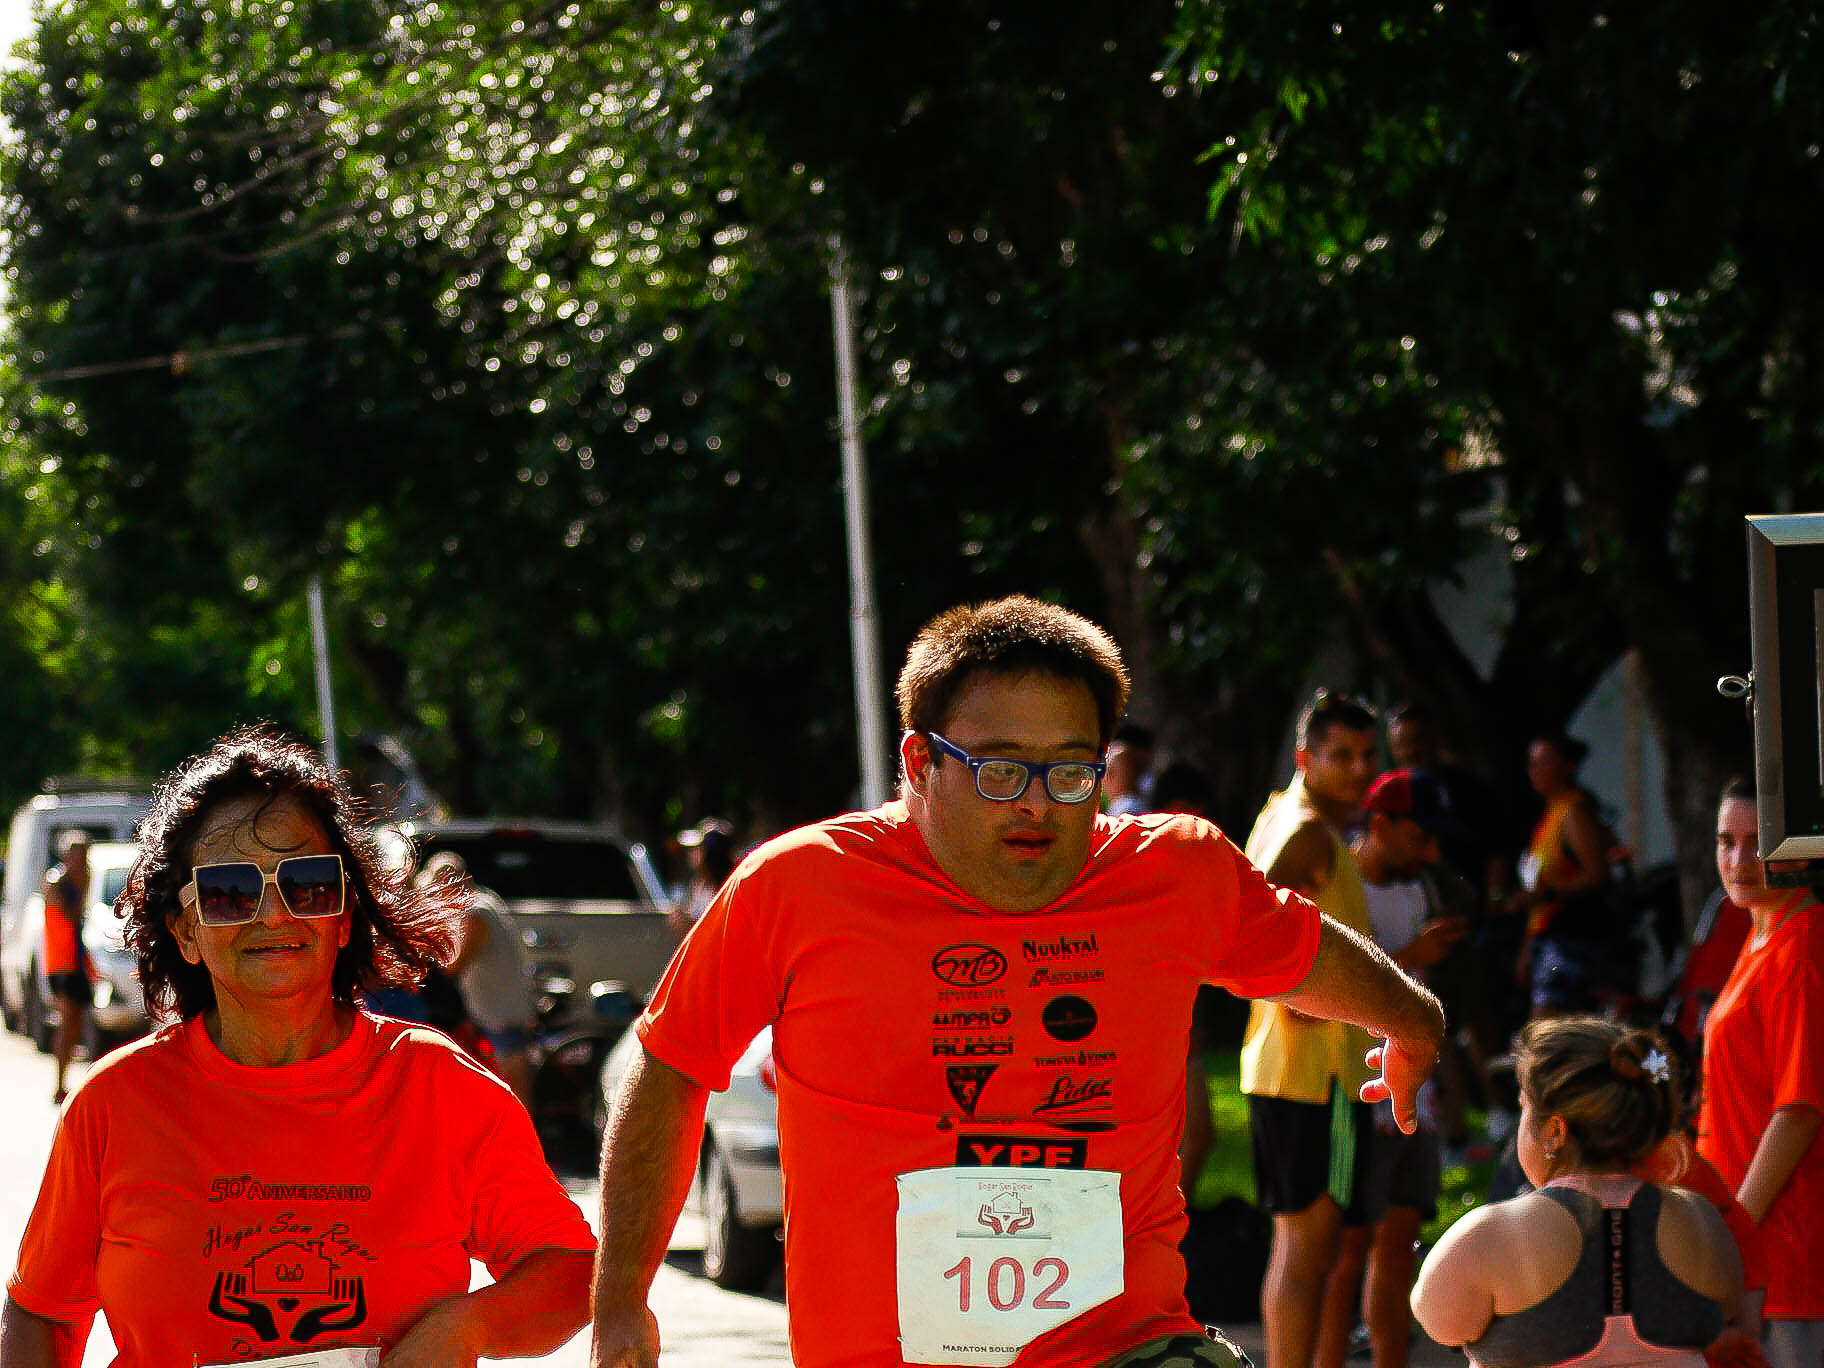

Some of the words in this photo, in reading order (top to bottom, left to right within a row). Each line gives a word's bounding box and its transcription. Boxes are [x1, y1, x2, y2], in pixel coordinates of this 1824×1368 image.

[932, 1042, 1014, 1056] RUCCI
[269, 1211, 313, 1234] San
[943, 1256, 1071, 1313] 102
[942, 1344, 988, 1353] MARATON
